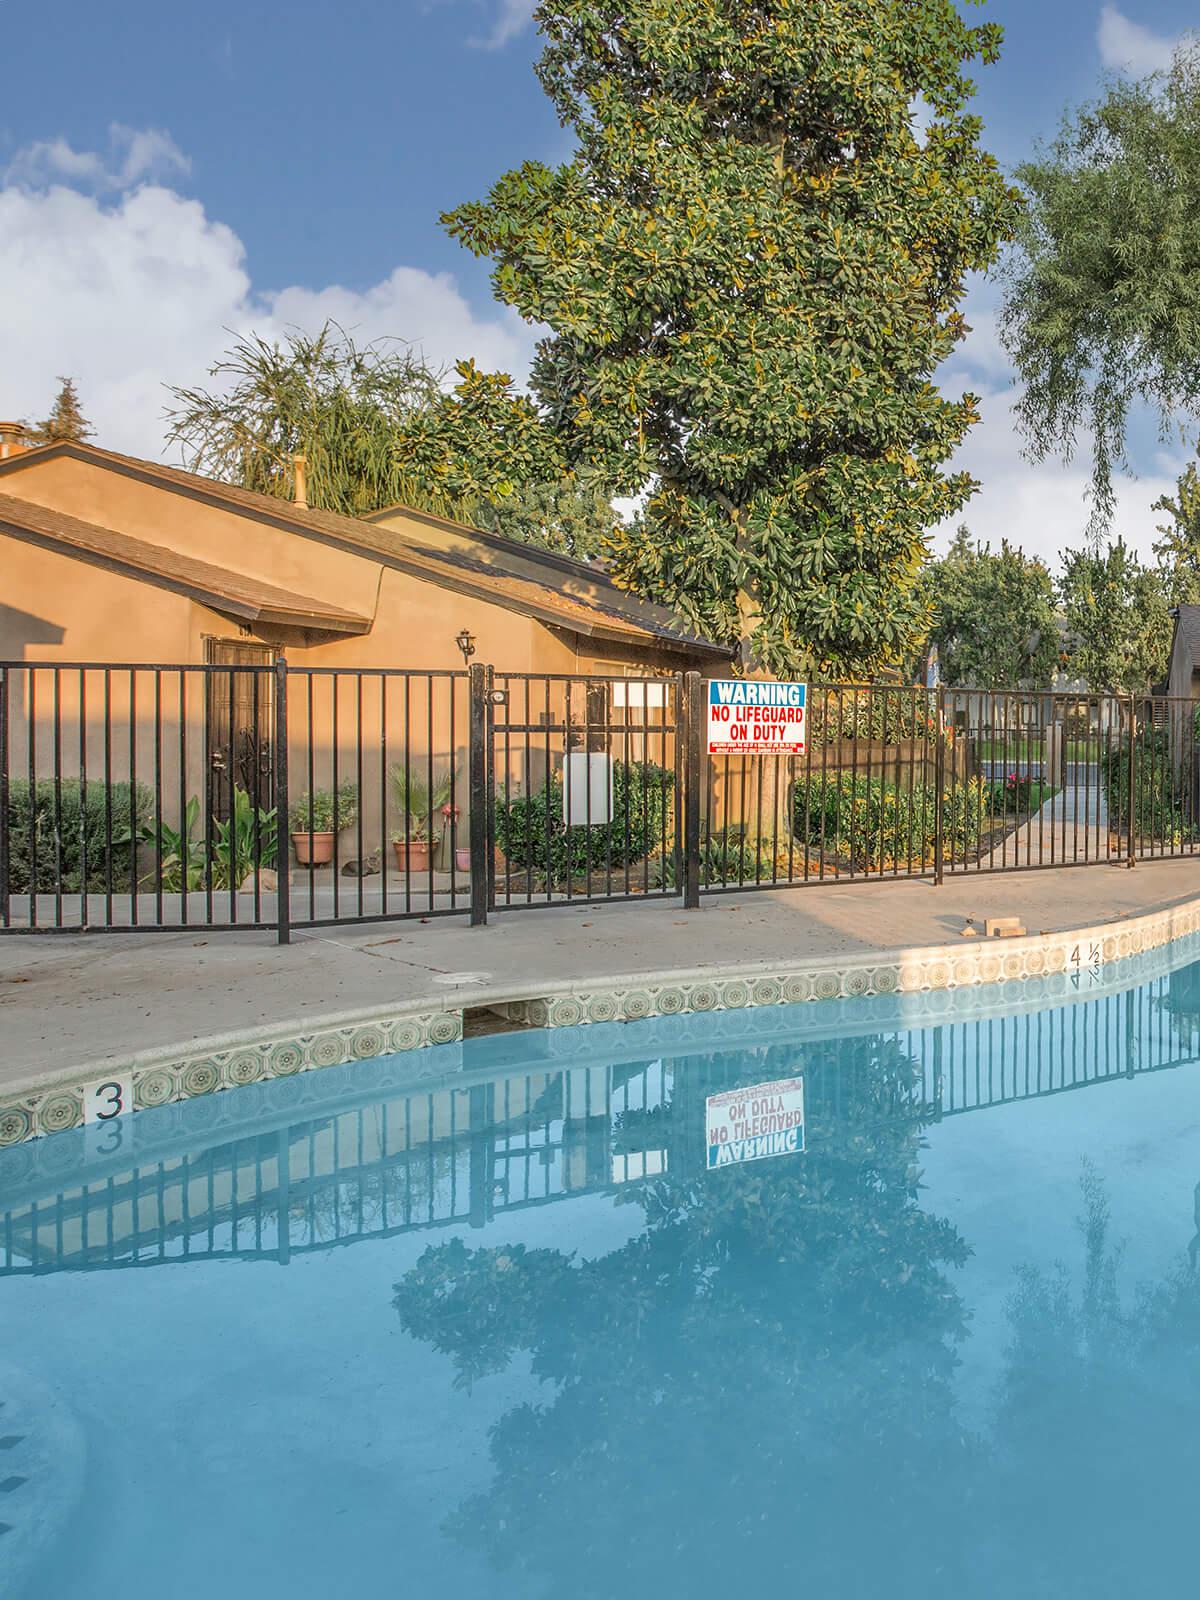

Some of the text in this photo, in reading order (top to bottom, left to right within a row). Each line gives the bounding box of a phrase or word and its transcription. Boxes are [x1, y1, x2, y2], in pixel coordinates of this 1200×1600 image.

[717, 683, 800, 706] WARNING
[711, 705, 803, 723] NO LIFEGUARD
[730, 724, 787, 741] ON DUTY
[1070, 944, 1080, 966] 4
[95, 1081, 123, 1120] 3
